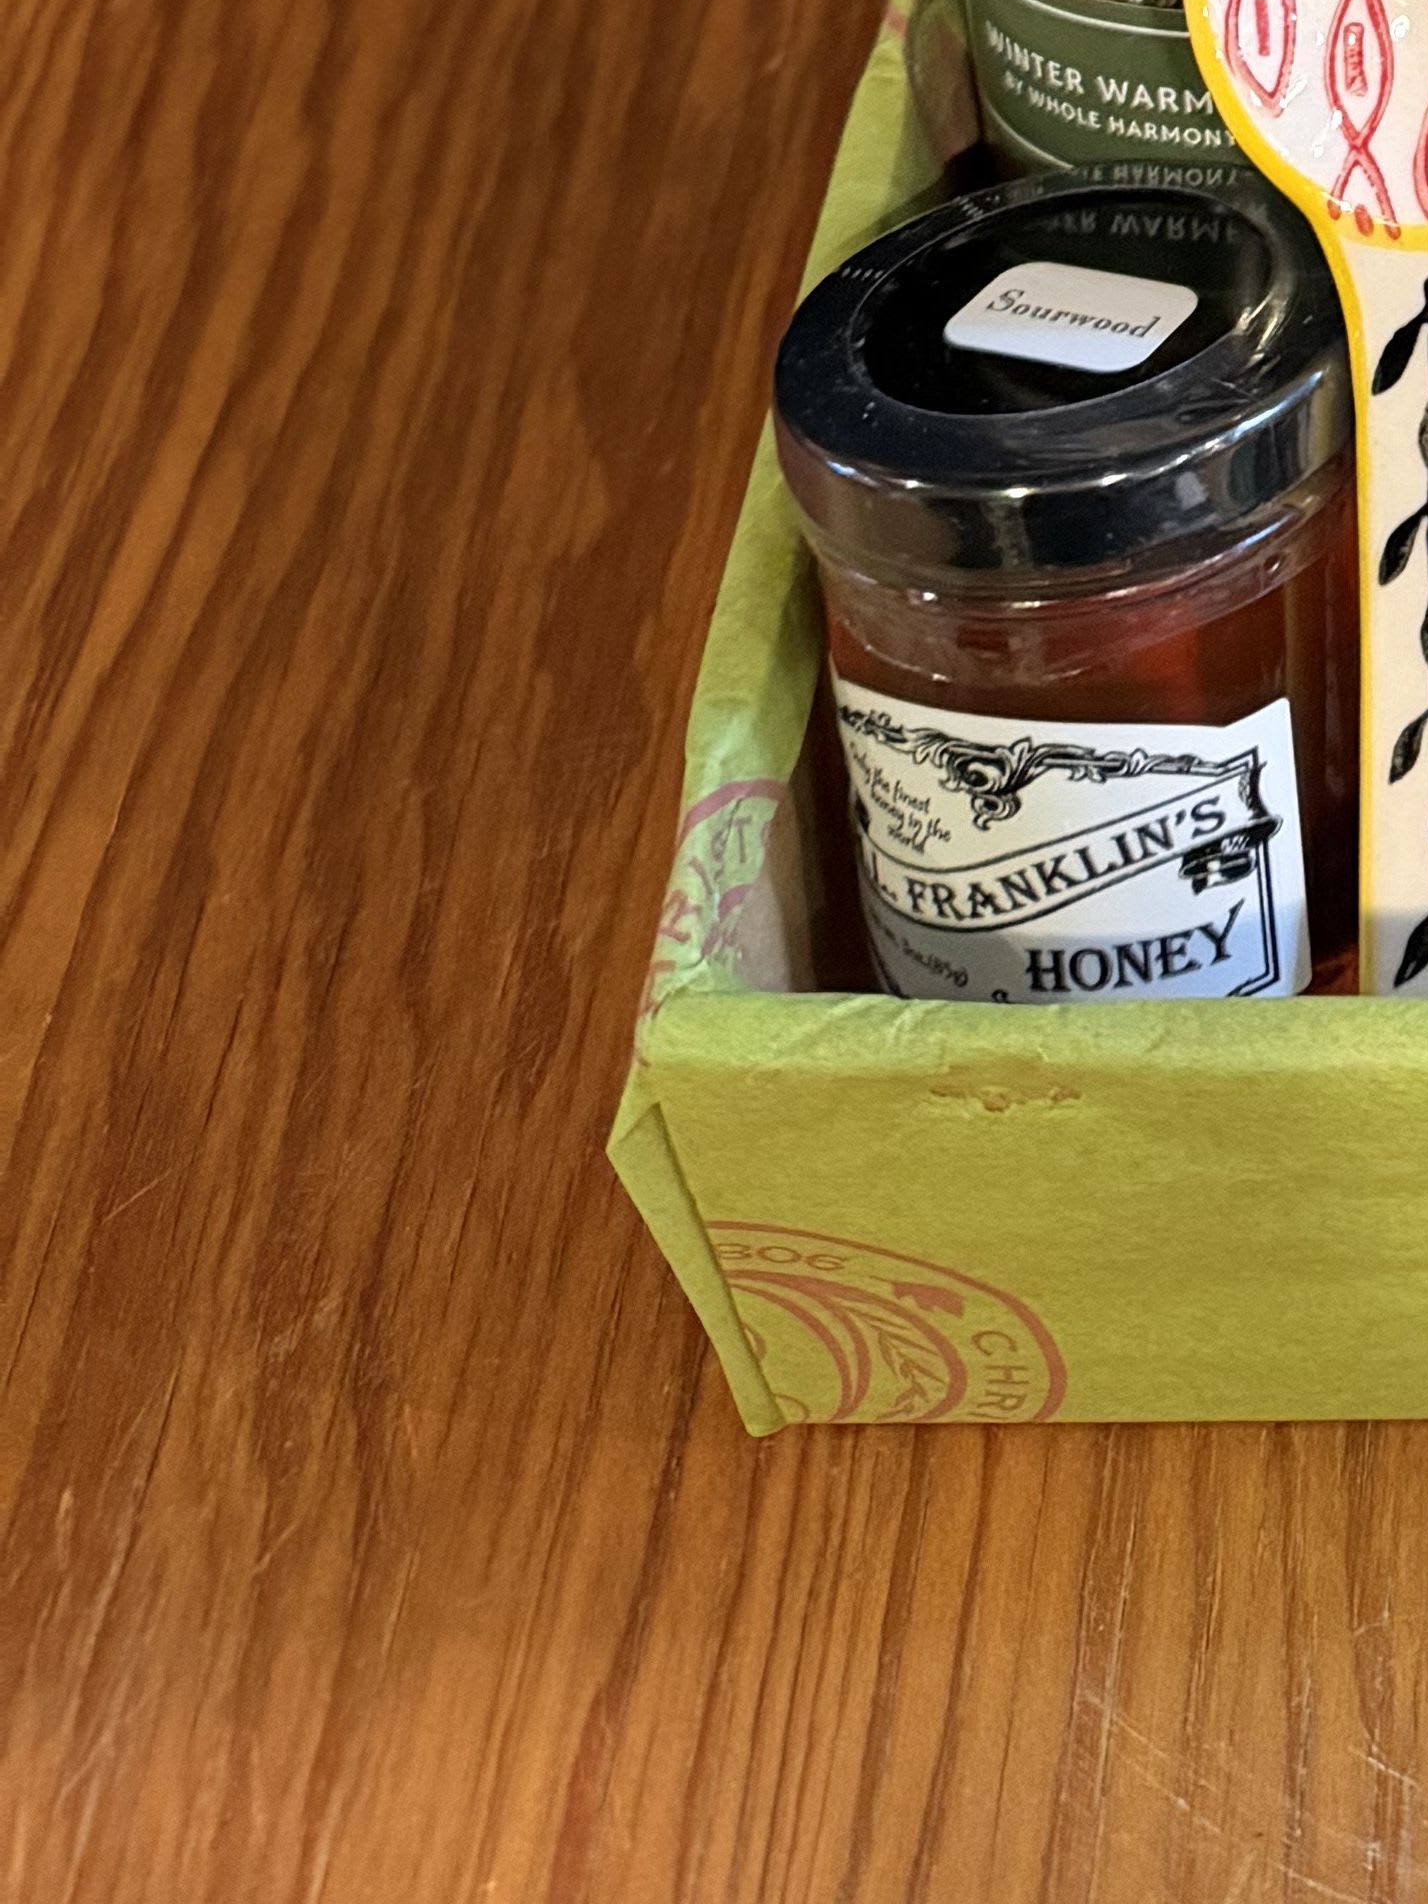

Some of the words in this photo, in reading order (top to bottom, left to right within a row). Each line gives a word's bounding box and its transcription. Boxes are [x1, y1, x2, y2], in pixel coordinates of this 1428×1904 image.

[985, 20, 1085, 95] WINTER
[1097, 75, 1214, 116] WARM
[1028, 87, 1101, 129] WHOLE
[986, 287, 1162, 341] Sourwood
[907, 796, 1226, 920] FRANKLIN'S
[1024, 898, 1244, 992] HONEY
